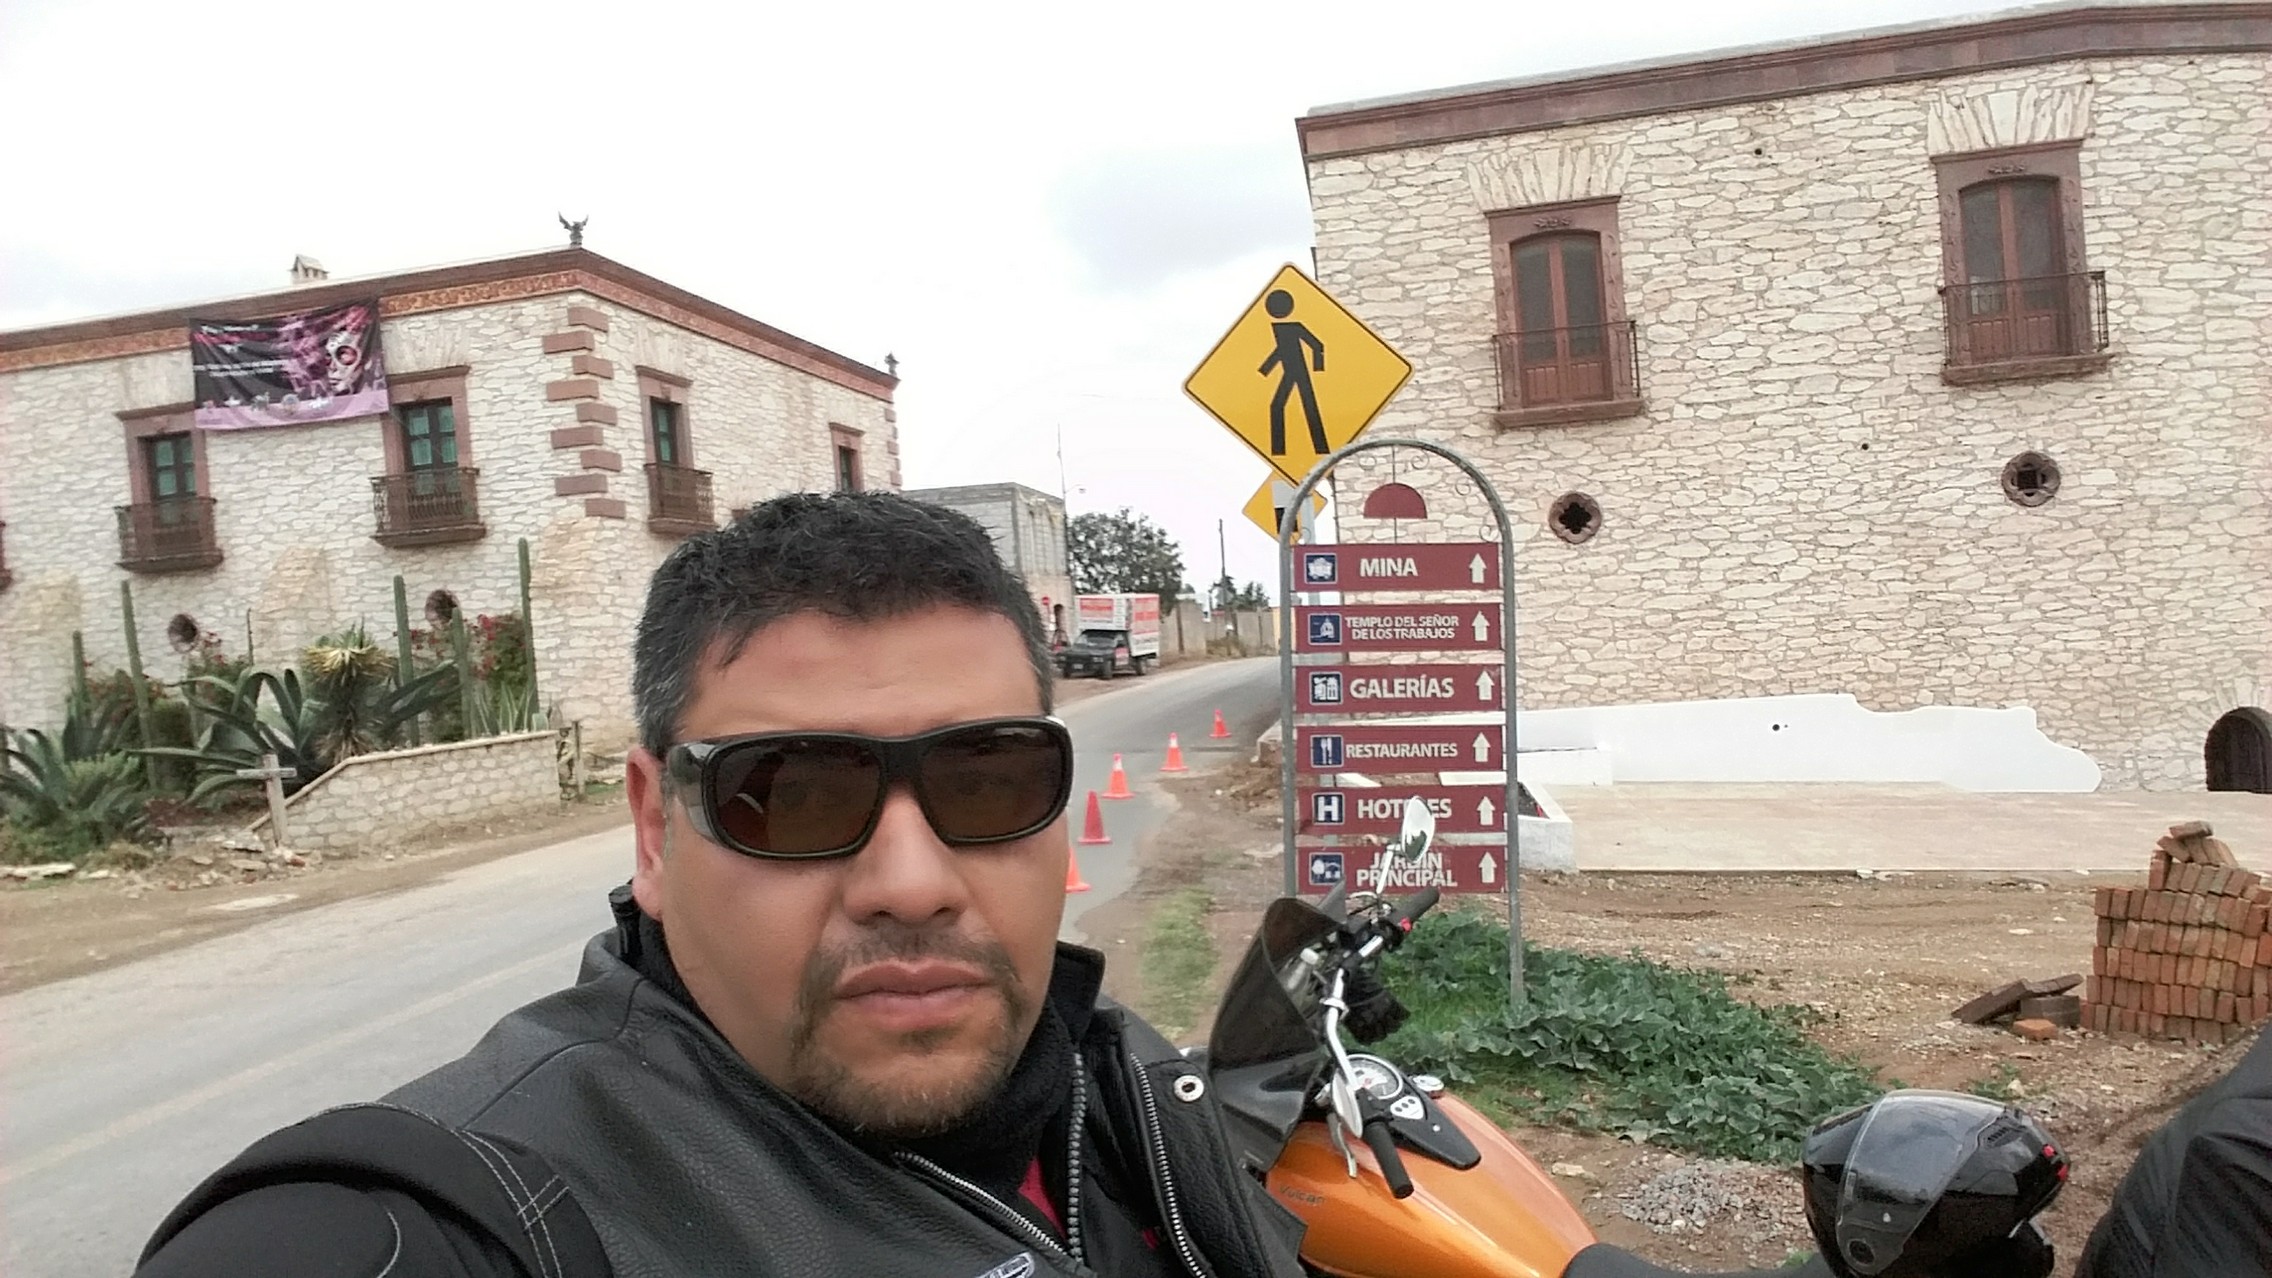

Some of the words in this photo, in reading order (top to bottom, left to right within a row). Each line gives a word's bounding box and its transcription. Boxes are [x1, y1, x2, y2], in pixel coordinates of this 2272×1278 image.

[1359, 557, 1418, 577] MINA
[1345, 616, 1393, 628] TEMPLO
[1394, 616, 1418, 627] DEL
[1419, 614, 1459, 627] SEÑOR
[1352, 628, 1369, 639] DE
[1369, 628, 1393, 639] LOS
[1393, 627, 1455, 639] TRABAJOS
[1350, 675, 1455, 699] GALERÍAS
[1345, 743, 1458, 758] RESTAURANTES
[1357, 798, 1452, 819] HOTES
